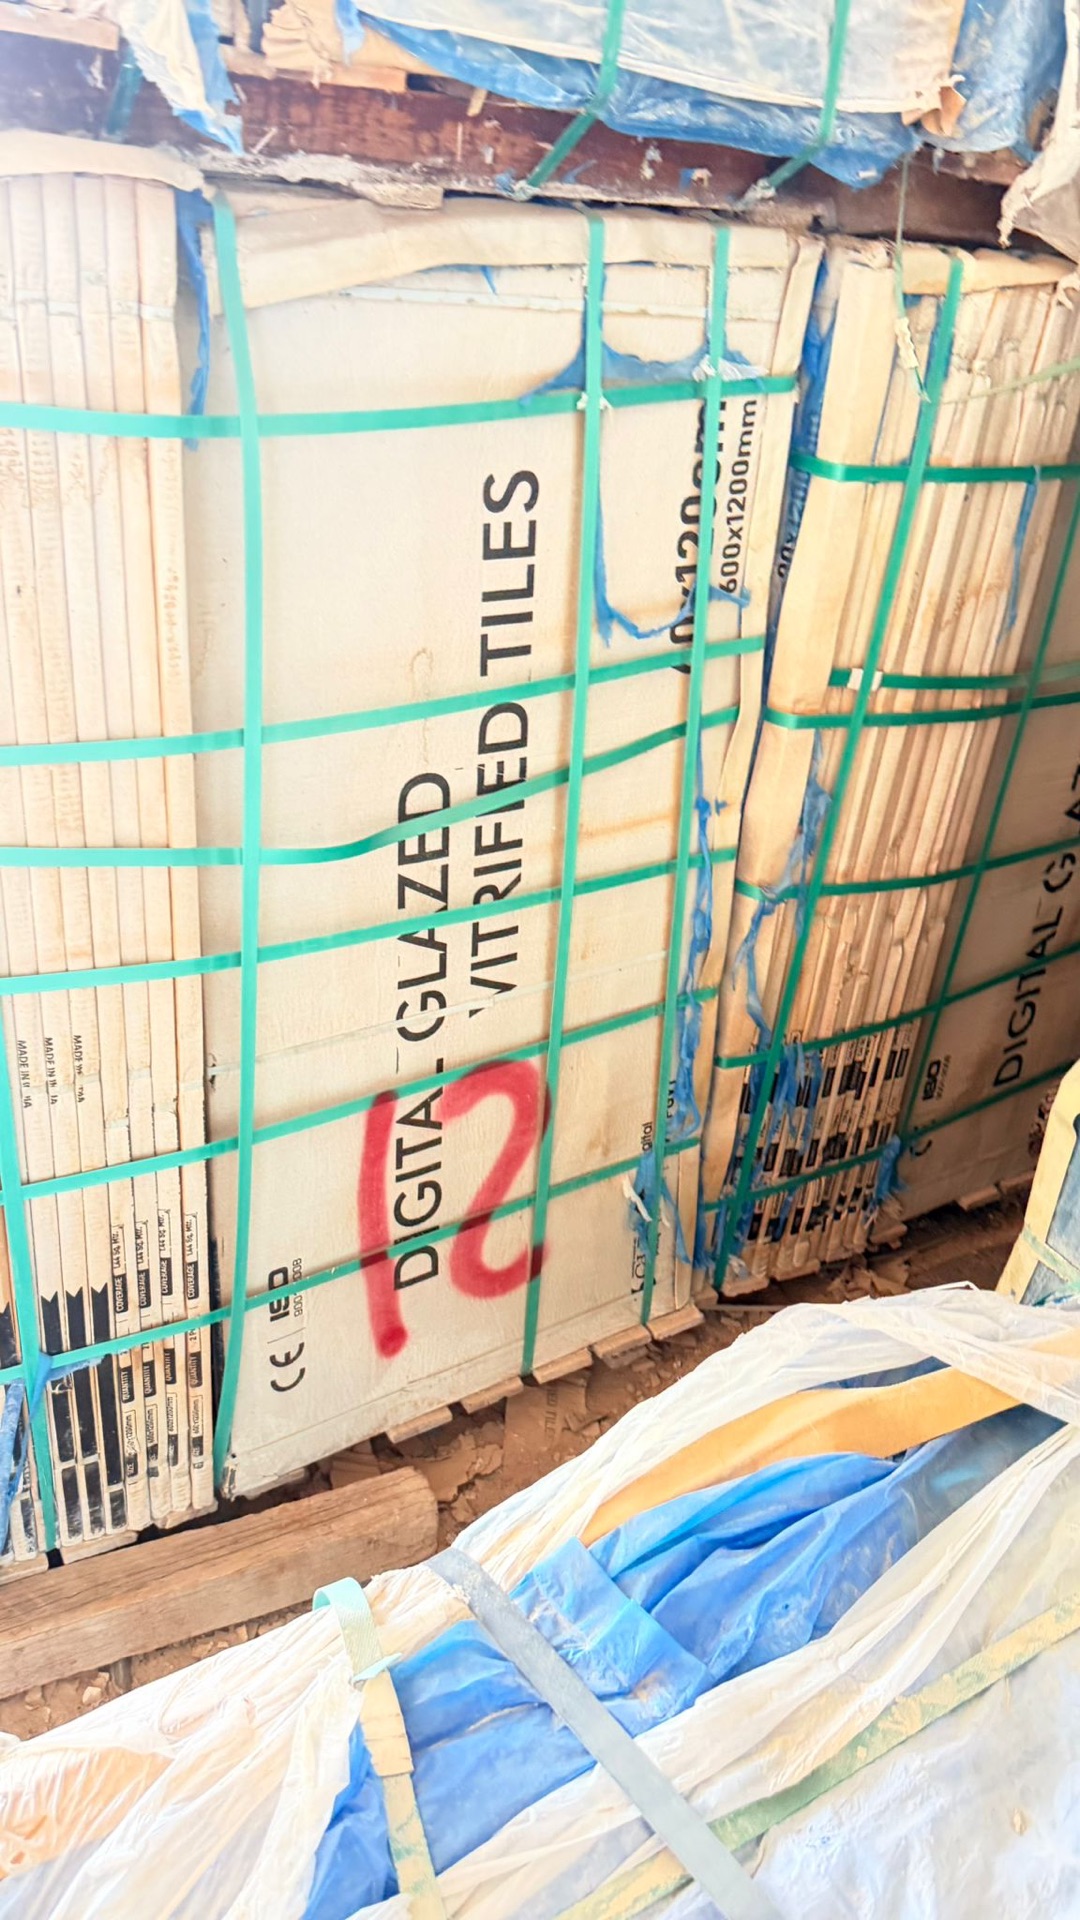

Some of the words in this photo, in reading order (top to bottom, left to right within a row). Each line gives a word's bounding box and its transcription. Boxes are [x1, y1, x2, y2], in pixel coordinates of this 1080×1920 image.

[719, 400, 757, 593] 600x1200mm
[480, 470, 540, 677] TILES
[469, 701, 528, 1018] VITRIFIED
[396, 773, 450, 1041] GLAZED
[992, 907, 1063, 1088] DIGITAL
[18, 1040, 28, 1068] MADE
[45, 1038, 54, 1065] MADE
[115, 1277, 124, 1312] COVERAGE
[268, 1267, 289, 1322] ISO
[121, 1371, 129, 1400] QUANTITY
[143, 1365, 152, 1394] QUANTITY
[190, 1356, 198, 1385] QUANTITY
